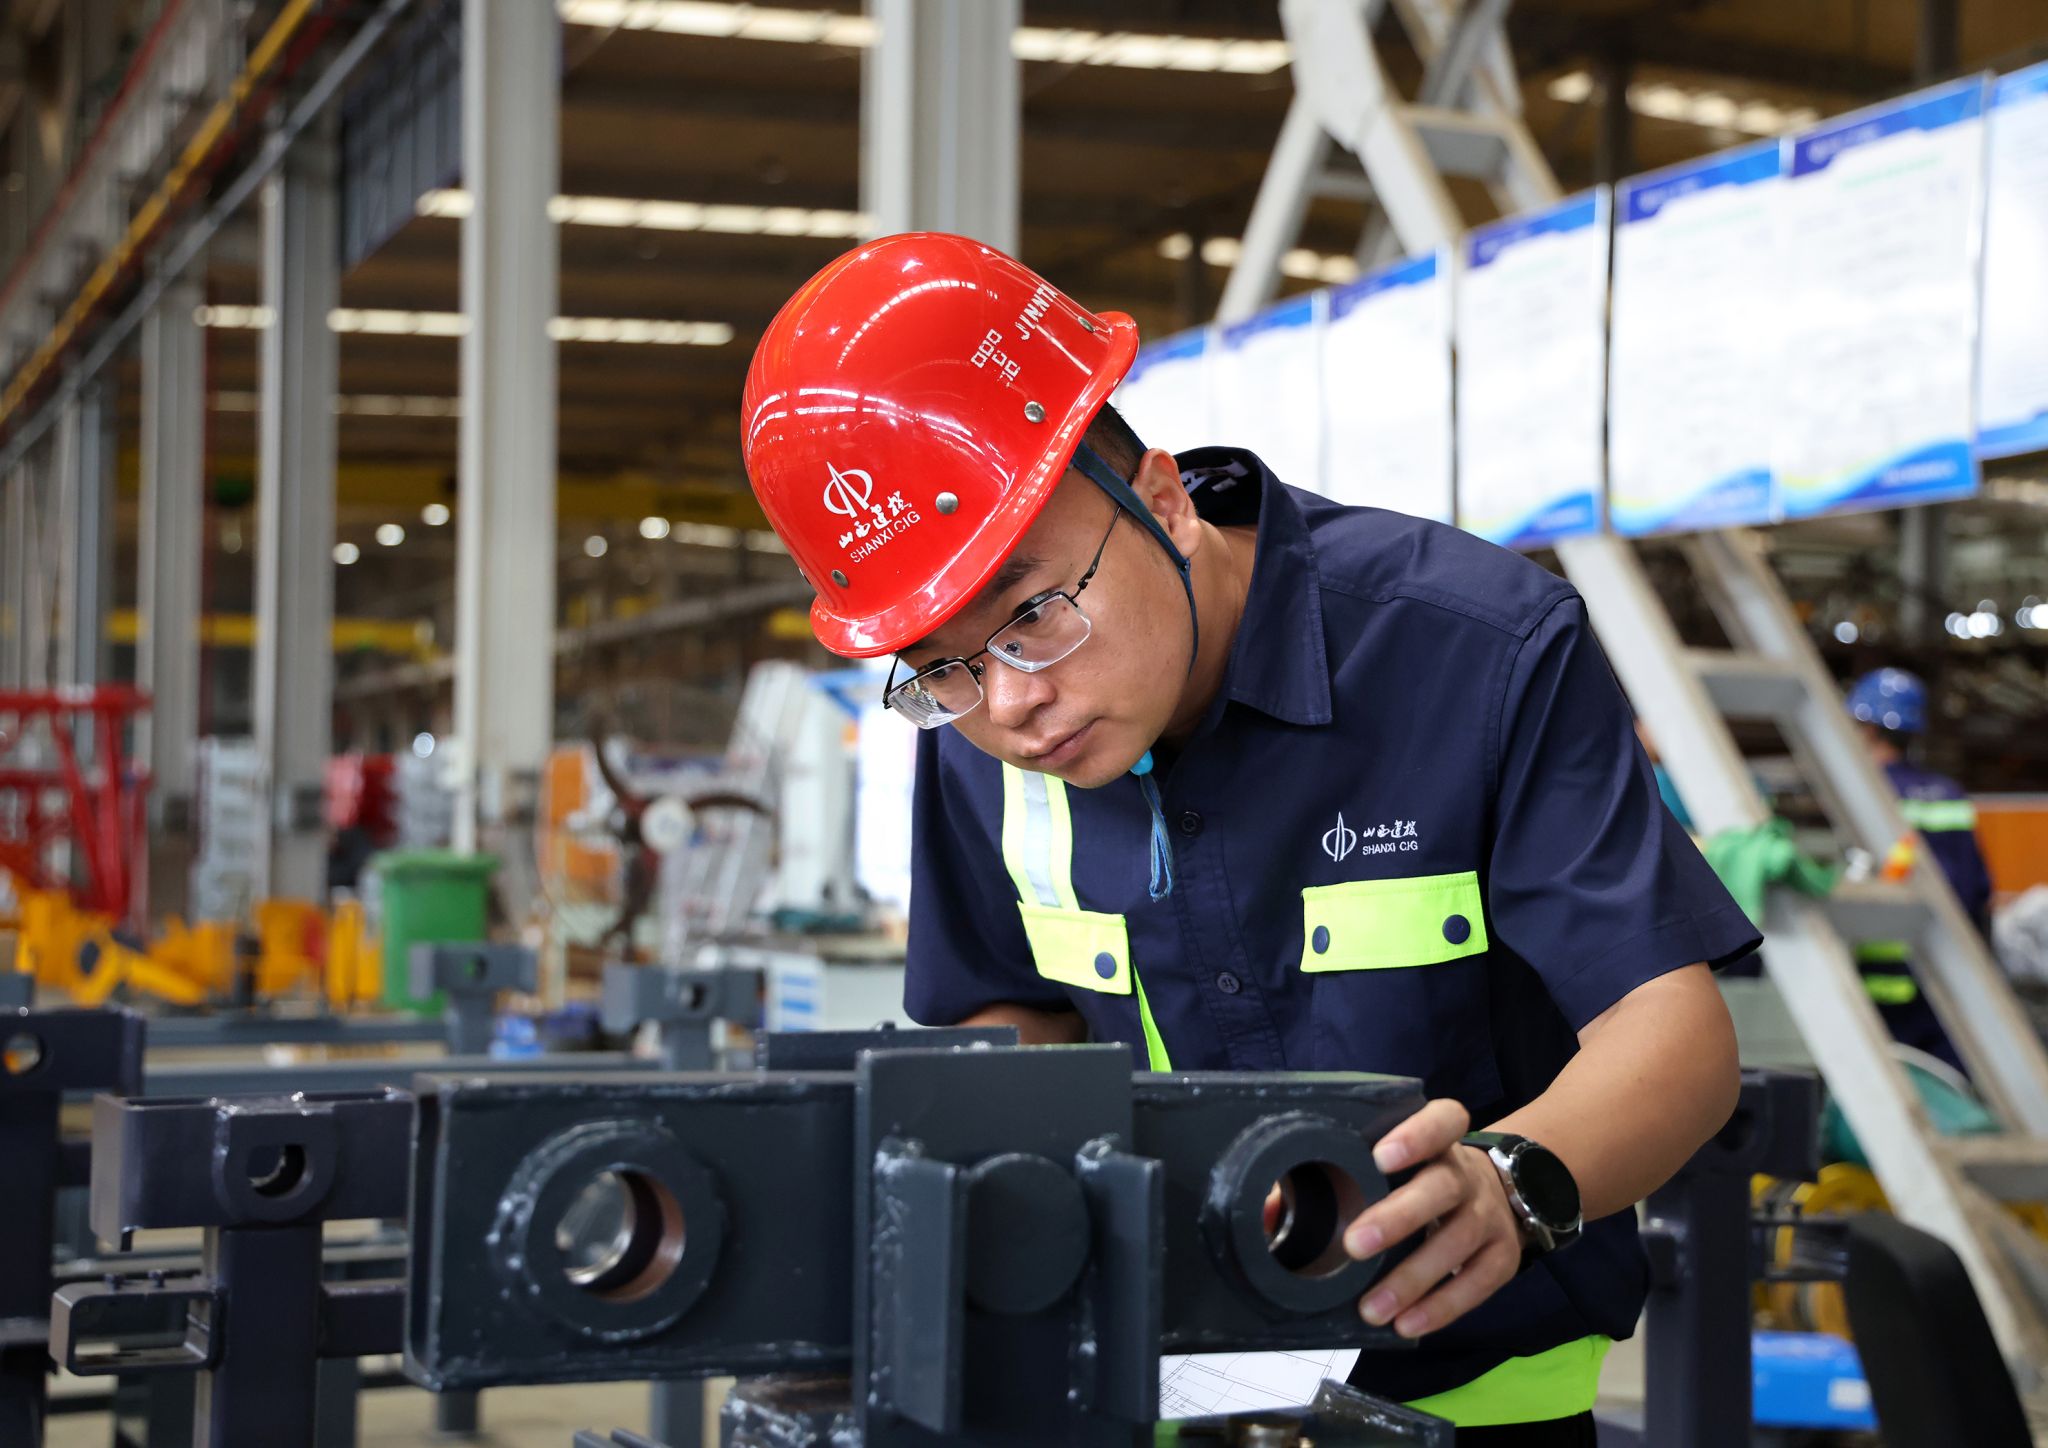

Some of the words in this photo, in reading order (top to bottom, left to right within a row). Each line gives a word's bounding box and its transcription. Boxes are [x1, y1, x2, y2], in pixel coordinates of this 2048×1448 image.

[850, 527, 895, 563] SHANXI
[893, 511, 920, 533] CIG
[1362, 842, 1396, 856] SHANXI
[1398, 840, 1419, 852] CIG
